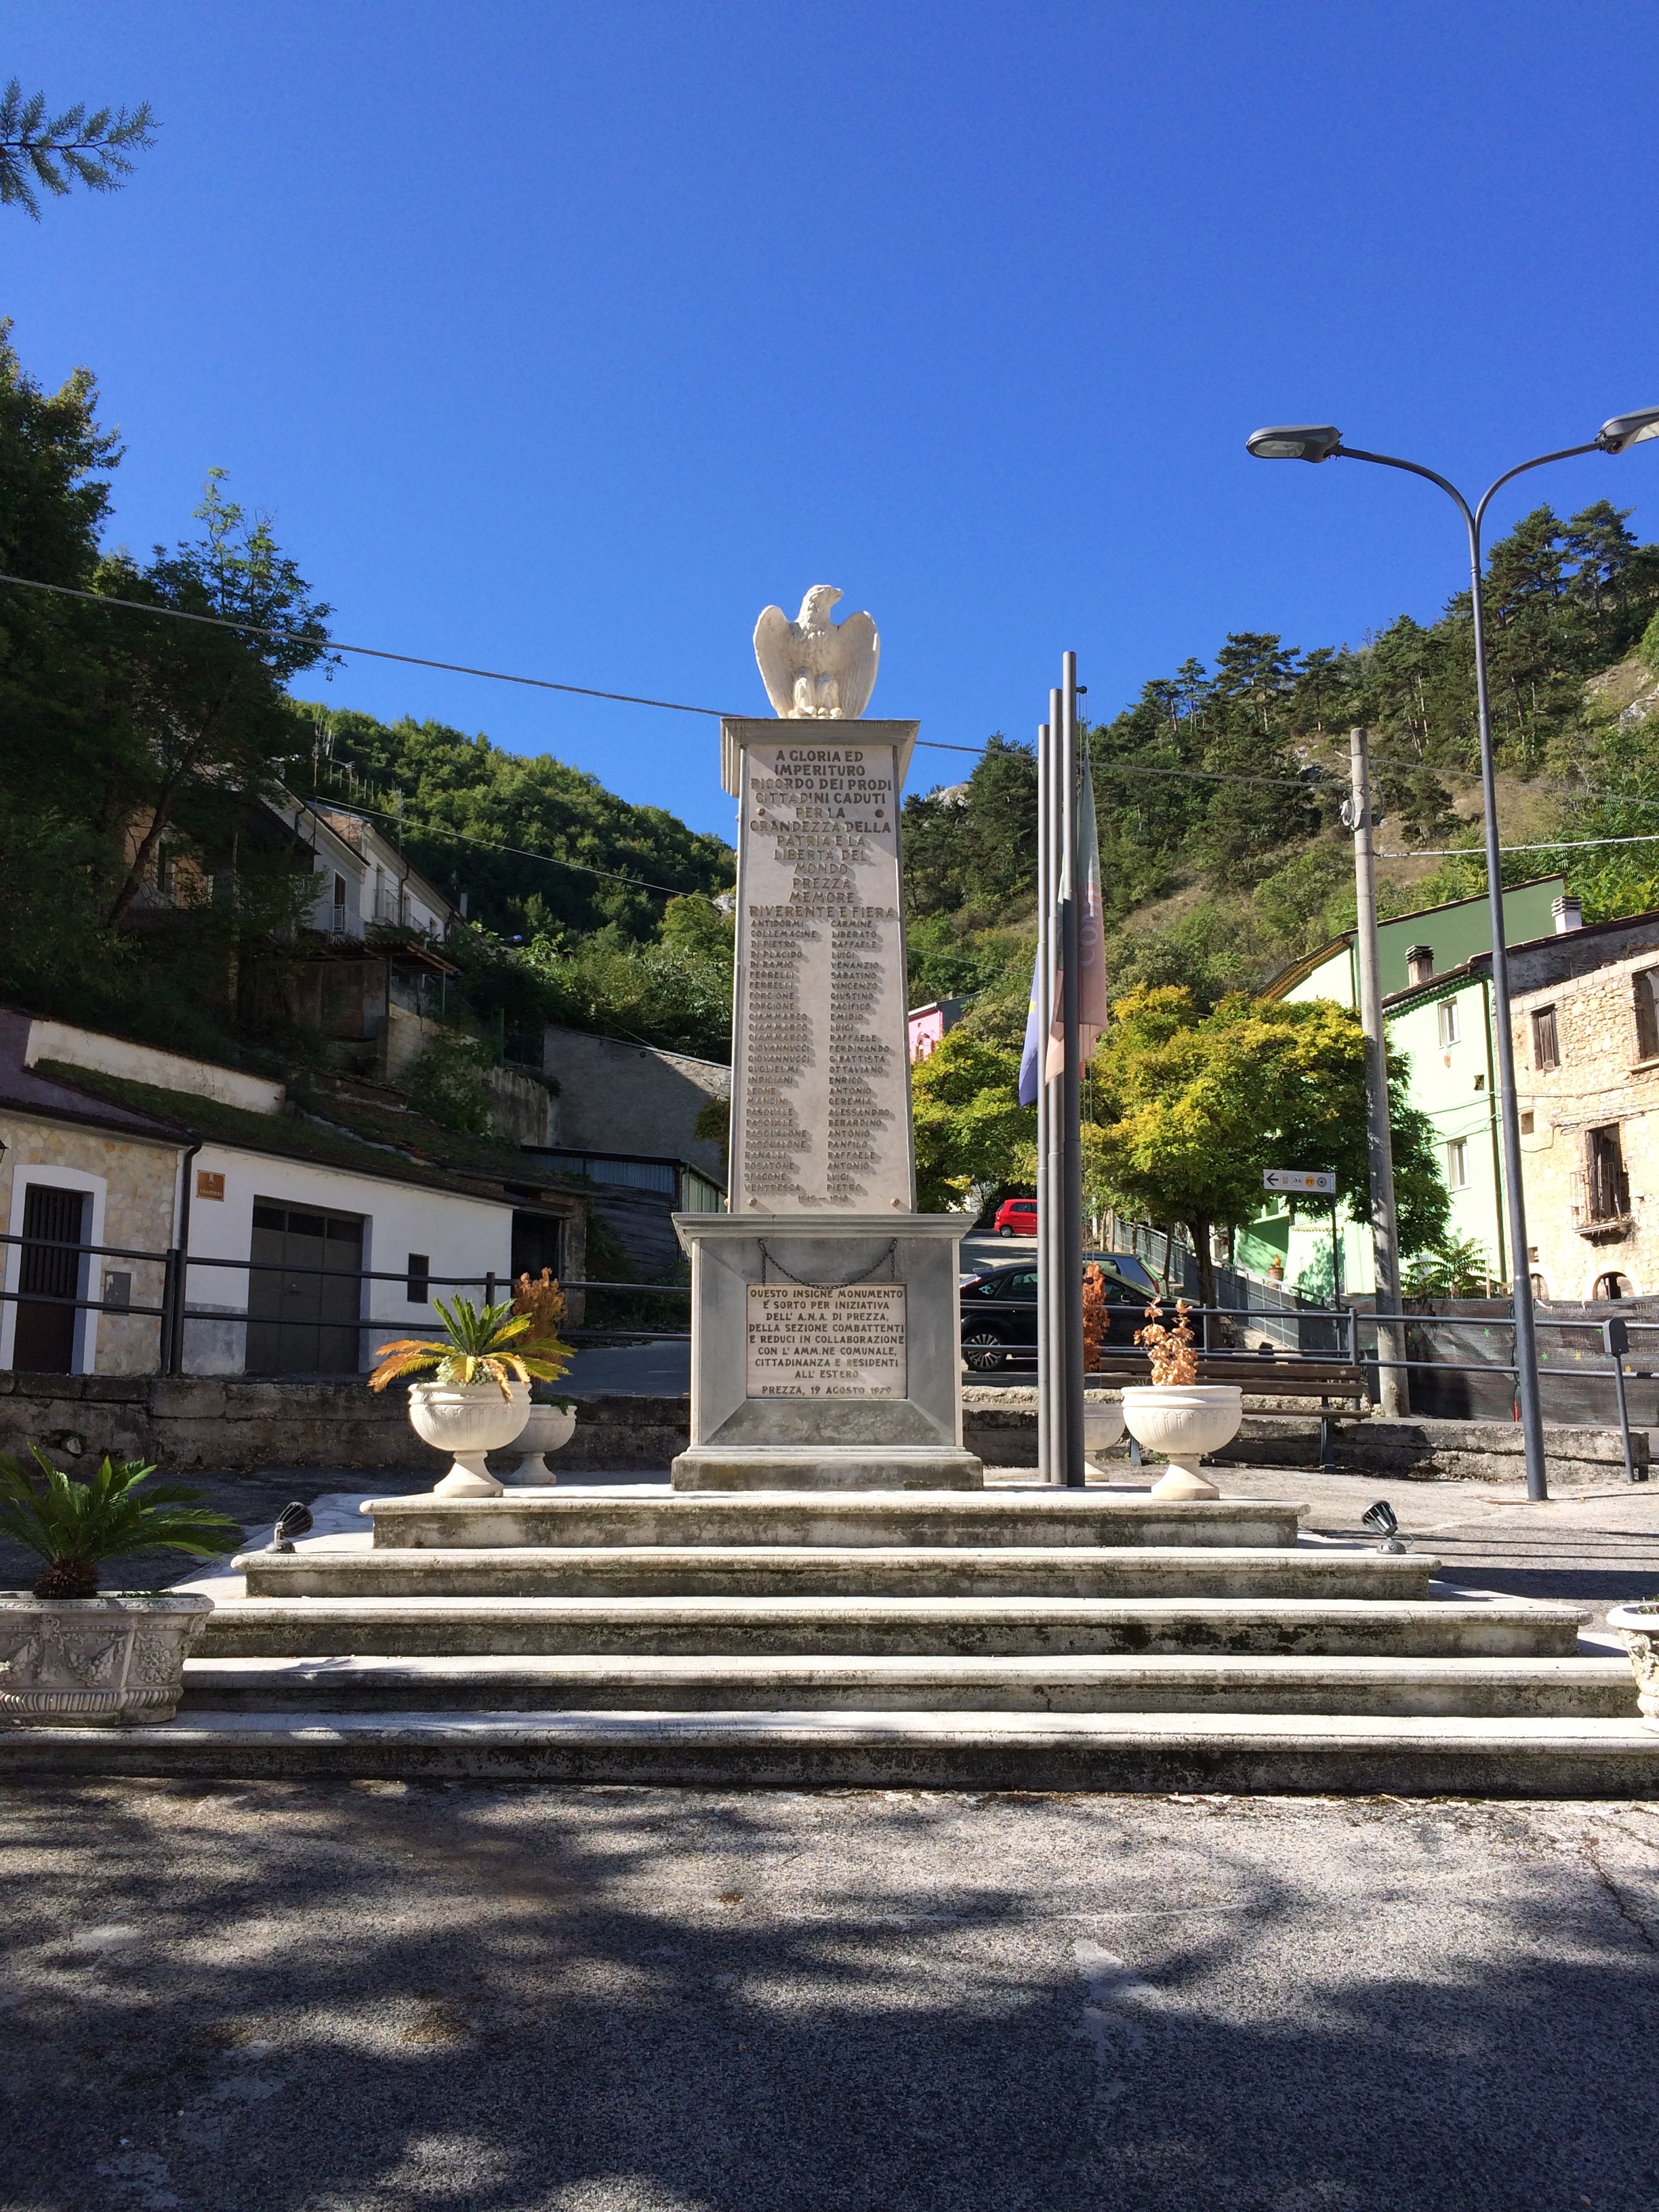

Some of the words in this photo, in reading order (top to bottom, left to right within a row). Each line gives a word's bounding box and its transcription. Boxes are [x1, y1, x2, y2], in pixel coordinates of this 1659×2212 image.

[776, 751, 785, 761] A
[790, 751, 840, 762] GLORIA
[844, 751, 863, 762] ED
[775, 764, 865, 776] IMPERITURO
[750, 778, 814, 790] RICORDO
[819, 779, 843, 790] DEI
[848, 779, 891, 791] PRODI
[755, 792, 829, 804] CITTADINI
[834, 793, 885, 804] CADUTI
[795, 807, 823, 819] PER
[827, 808, 845, 819] LA
[750, 820, 840, 833] GRANDEZZA
[844, 821, 890, 833] DELLA
[777, 835, 830, 846] PATRIA
[835, 836, 842, 846] E
[848, 835, 865, 846] LA
[841, 850, 867, 861] DEL
[794, 863, 847, 874] MONDO
[792, 878, 851, 889] PREZZA
[789, 891, 854, 903] MEMORE
[749, 905, 834, 918] RIVERENTE
[839, 907, 847, 918] E
[851, 907, 894, 918] FIERA
[750, 1290, 787, 1298] QUESTO
[794, 1290, 833, 1298] INSIGNE
[838, 1290, 903, 1298] MONUMENTO
[773, 1301, 806, 1309] SORTO
[811, 1301, 830, 1309] PER
[835, 1301, 889, 1309] INIZIATIVA
[766, 1312, 792, 1321] DELL'
[832, 1313, 842, 1321] DI
[847, 1313, 889, 1322] PREZZA,
[749, 1324, 780, 1332] DELLA
[785, 1324, 827, 1332] SEZIONE
[832, 1324, 904, 1333] COMBATTENTI
[750, 1335, 755, 1343] E
[760, 1335, 795, 1344] REDUCI
[800, 1335, 811, 1344] IN
[815, 1335, 904, 1345] COLLABORAZIONE
[758, 1347, 777, 1355] CON
[782, 1347, 790, 1355] L'
[794, 1347, 835, 1355] AMM.NE
[840, 1347, 897, 1357] COMUNALE,
[755, 1358, 830, 1367] CITTADINANZA
[835, 1359, 840, 1367] E
[846, 1359, 898, 1367] RESIDENTI
[795, 1370, 815, 1378] ALL'
[820, 1370, 858, 1378] ESTERO
[762, 1386, 805, 1396] PREZZA,
[811, 1386, 821, 1395] 19
[825, 1386, 865, 1395] AGOSTO
[870, 1386, 892, 1395] 1979
